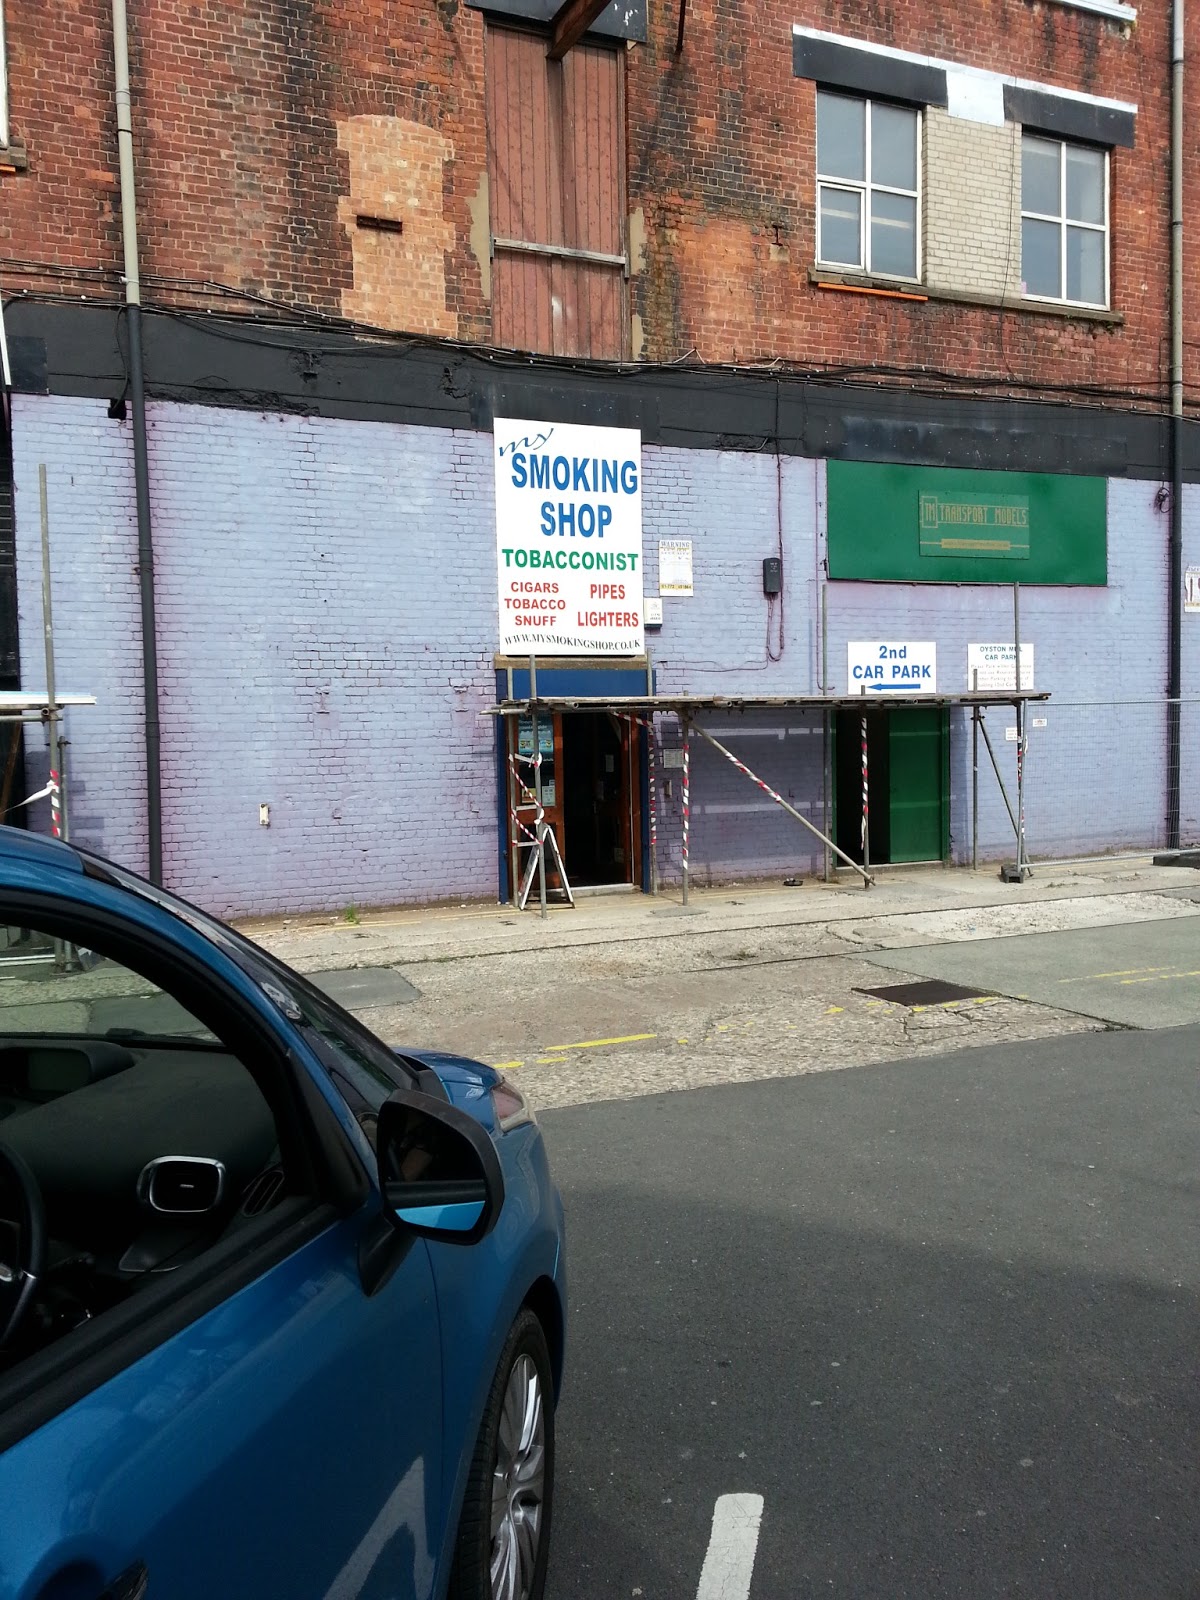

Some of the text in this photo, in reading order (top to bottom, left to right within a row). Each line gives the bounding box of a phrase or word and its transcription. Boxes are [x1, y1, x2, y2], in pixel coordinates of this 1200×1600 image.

[499, 428, 554, 457] my
[511, 453, 638, 495] SMOKING
[540, 501, 612, 538] SHOP
[941, 505, 988, 523] TRANSPORT
[995, 507, 1027, 525] MODELS
[501, 548, 639, 571] TOBACCONIST
[510, 581, 560, 593] CIGARS
[590, 584, 626, 599] PIPES
[504, 598, 566, 610] TOBACCO
[514, 615, 557, 626] SNUFF
[577, 611, 639, 627] LIGHTERS
[504, 633, 640, 651] WWW.MYSMOKINGSHOP.CO.UK
[879, 645, 907, 659] 2nd
[853, 665, 931, 679] CAR PARK
